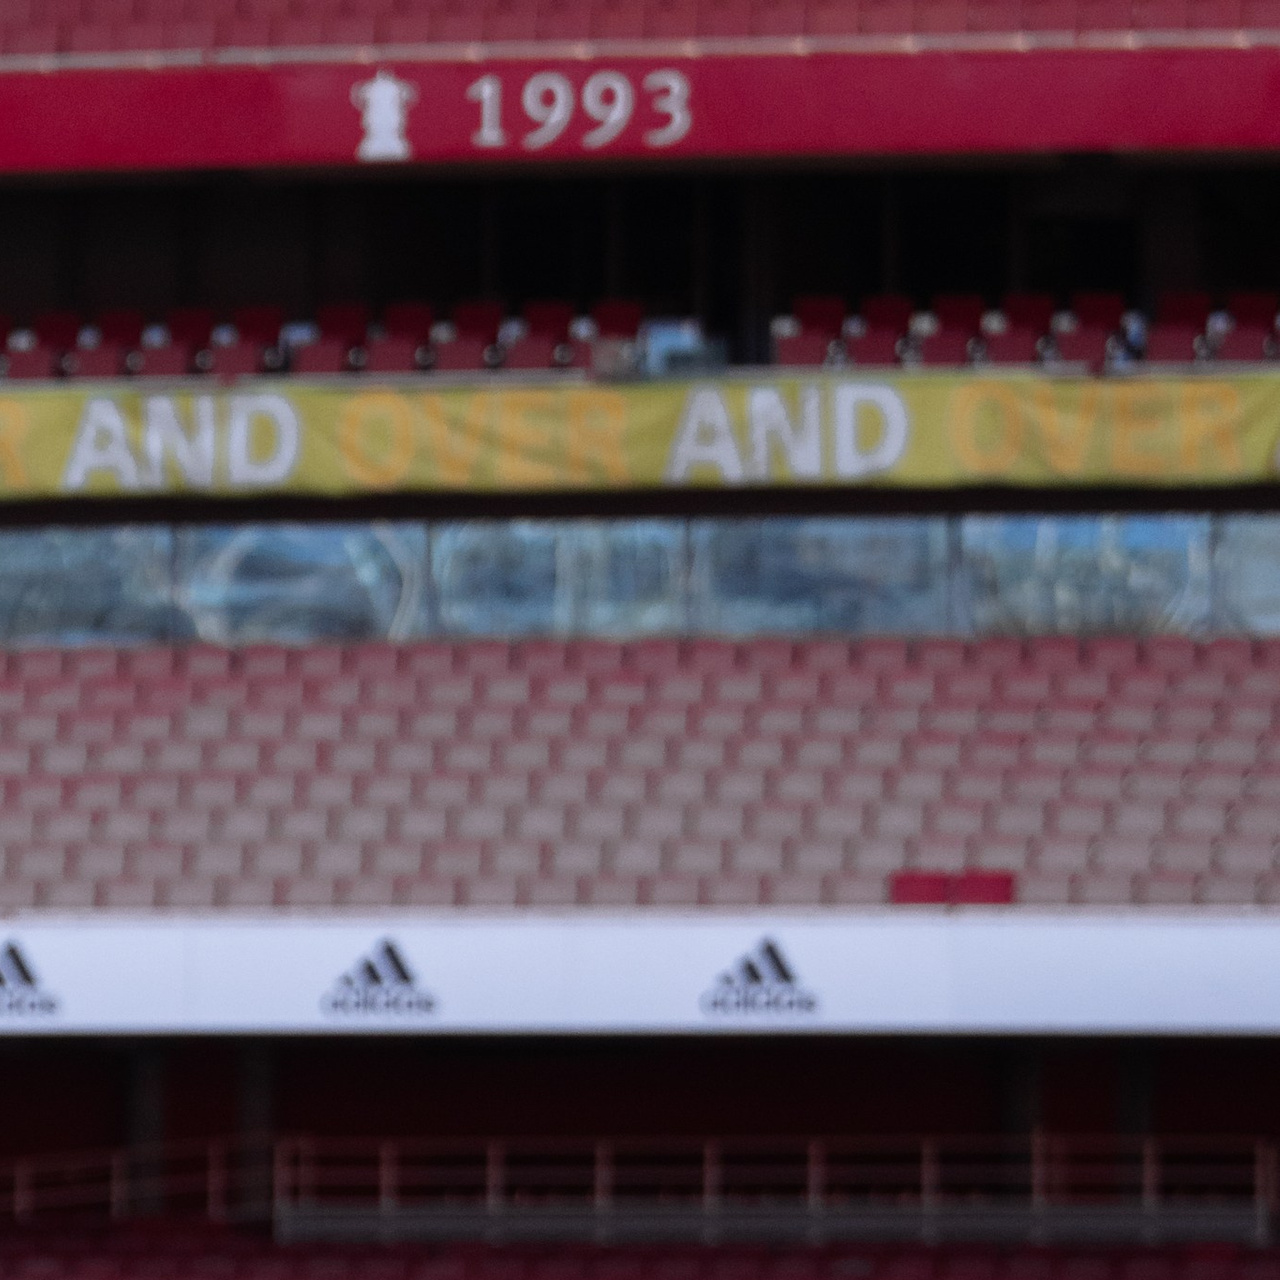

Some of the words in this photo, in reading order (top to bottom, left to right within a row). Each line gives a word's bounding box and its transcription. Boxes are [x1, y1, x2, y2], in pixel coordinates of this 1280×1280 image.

[465, 68, 693, 151] 1993
[59, 392, 302, 493] AND
[338, 388, 632, 488] OVER
[665, 382, 910, 487] AND
[947, 380, 1242, 475] OVER
